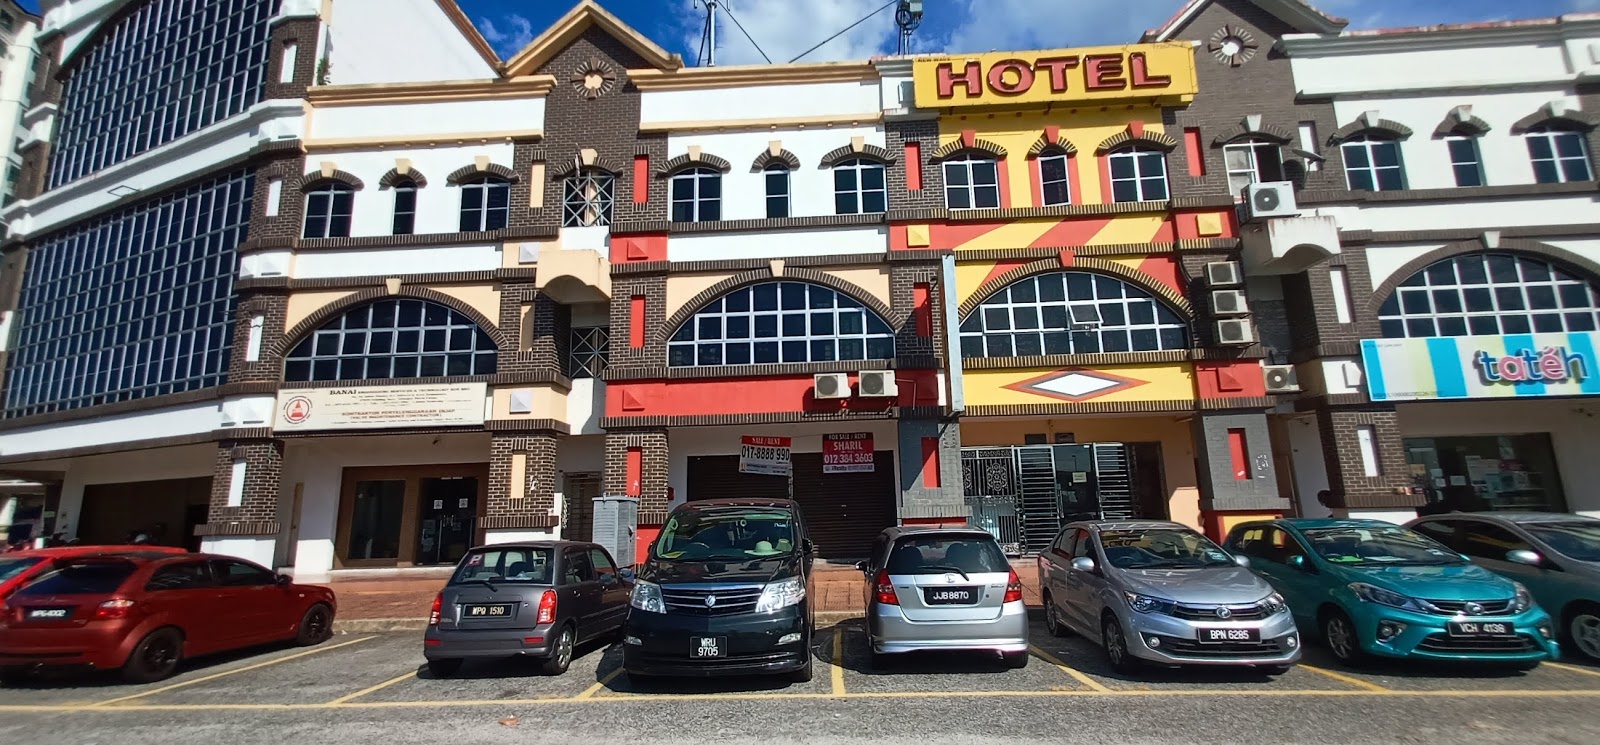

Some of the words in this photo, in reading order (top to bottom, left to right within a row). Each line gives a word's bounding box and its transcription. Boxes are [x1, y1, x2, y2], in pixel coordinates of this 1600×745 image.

[936, 51, 1172, 99] HOTEL
[1478, 346, 1591, 381] tatéh
[767, 437, 781, 445] RENT
[833, 441, 863, 451] SHARIL
[741, 445, 775, 460] 017-8888
[776, 448, 790, 461] 990
[824, 454, 838, 463] 012
[839, 454, 853, 463] 384
[854, 453, 873, 463] 3603
[933, 591, 969, 600] JJB8870
[472, 606, 487, 615] WPQ
[489, 606, 505, 615] 1510
[1459, 623, 1479, 633] VCH
[1210, 629, 1227, 639] BPN
[1228, 629, 1249, 640] 6285
[700, 637, 716, 647] WRU
[698, 646, 719, 656] 9705
